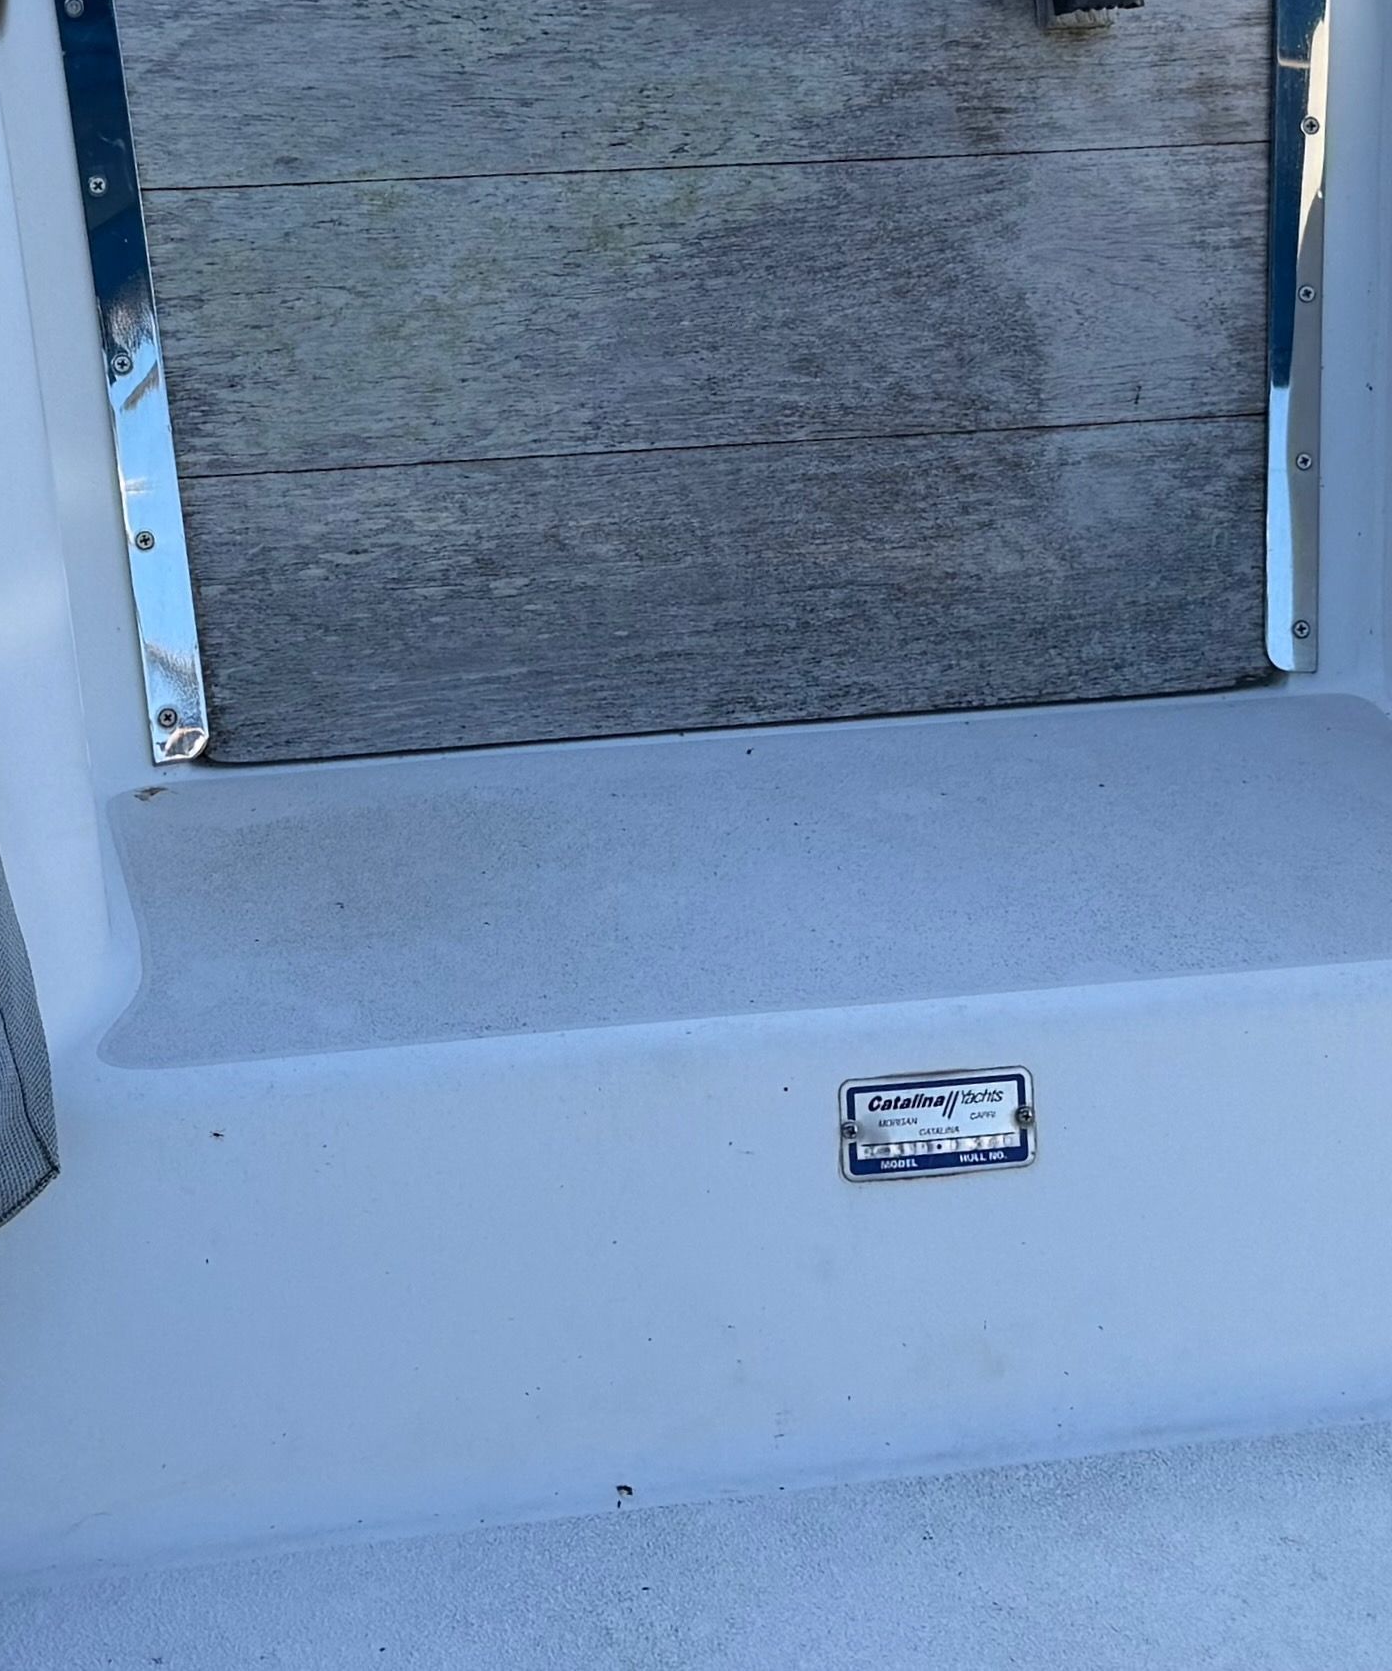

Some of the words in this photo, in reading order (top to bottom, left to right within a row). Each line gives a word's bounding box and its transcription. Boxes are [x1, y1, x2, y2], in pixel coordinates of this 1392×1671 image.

[868, 1093, 944, 1112] Catalina
[960, 1088, 1004, 1105] Yachts
[880, 1158, 918, 1170] MODEL
[959, 1153, 987, 1163] HULL
